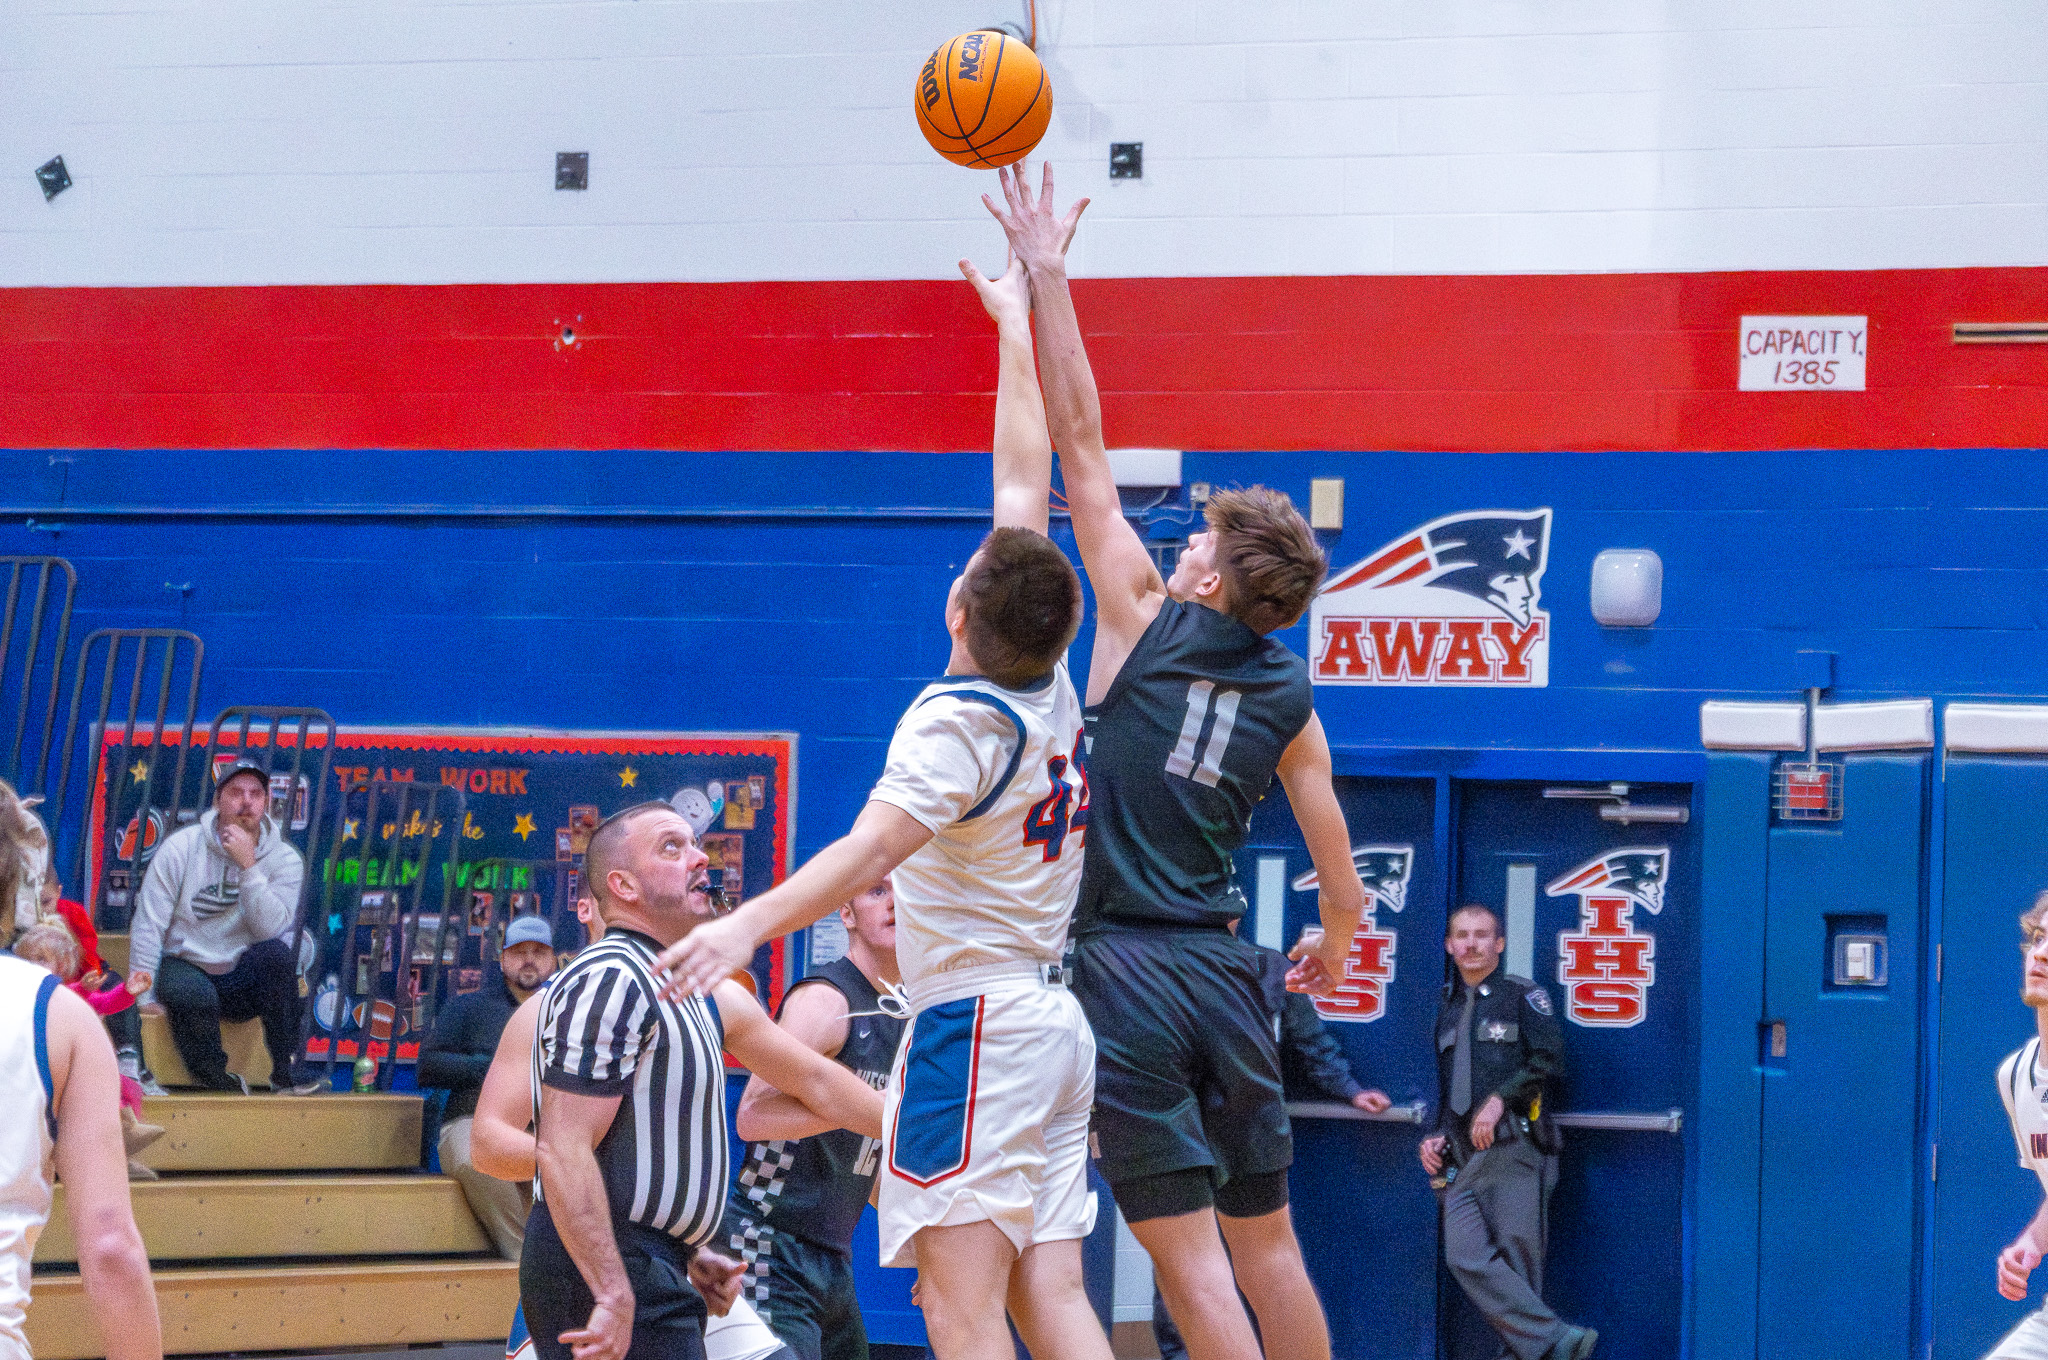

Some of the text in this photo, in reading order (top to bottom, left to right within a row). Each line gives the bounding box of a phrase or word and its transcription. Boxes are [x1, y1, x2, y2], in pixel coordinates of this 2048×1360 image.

[959, 34, 986, 83] NCAA
[1746, 330, 1863, 355] CAPACITY
[1774, 361, 1840, 385] 1385
[1314, 615, 1546, 683] AWAY
[1165, 679, 1242, 789] 11
[333, 766, 529, 795] TEAM WORK
[460, 811, 485, 841] he
[1304, 893, 1394, 1019] HS
[1563, 896, 1652, 1024] IHS
